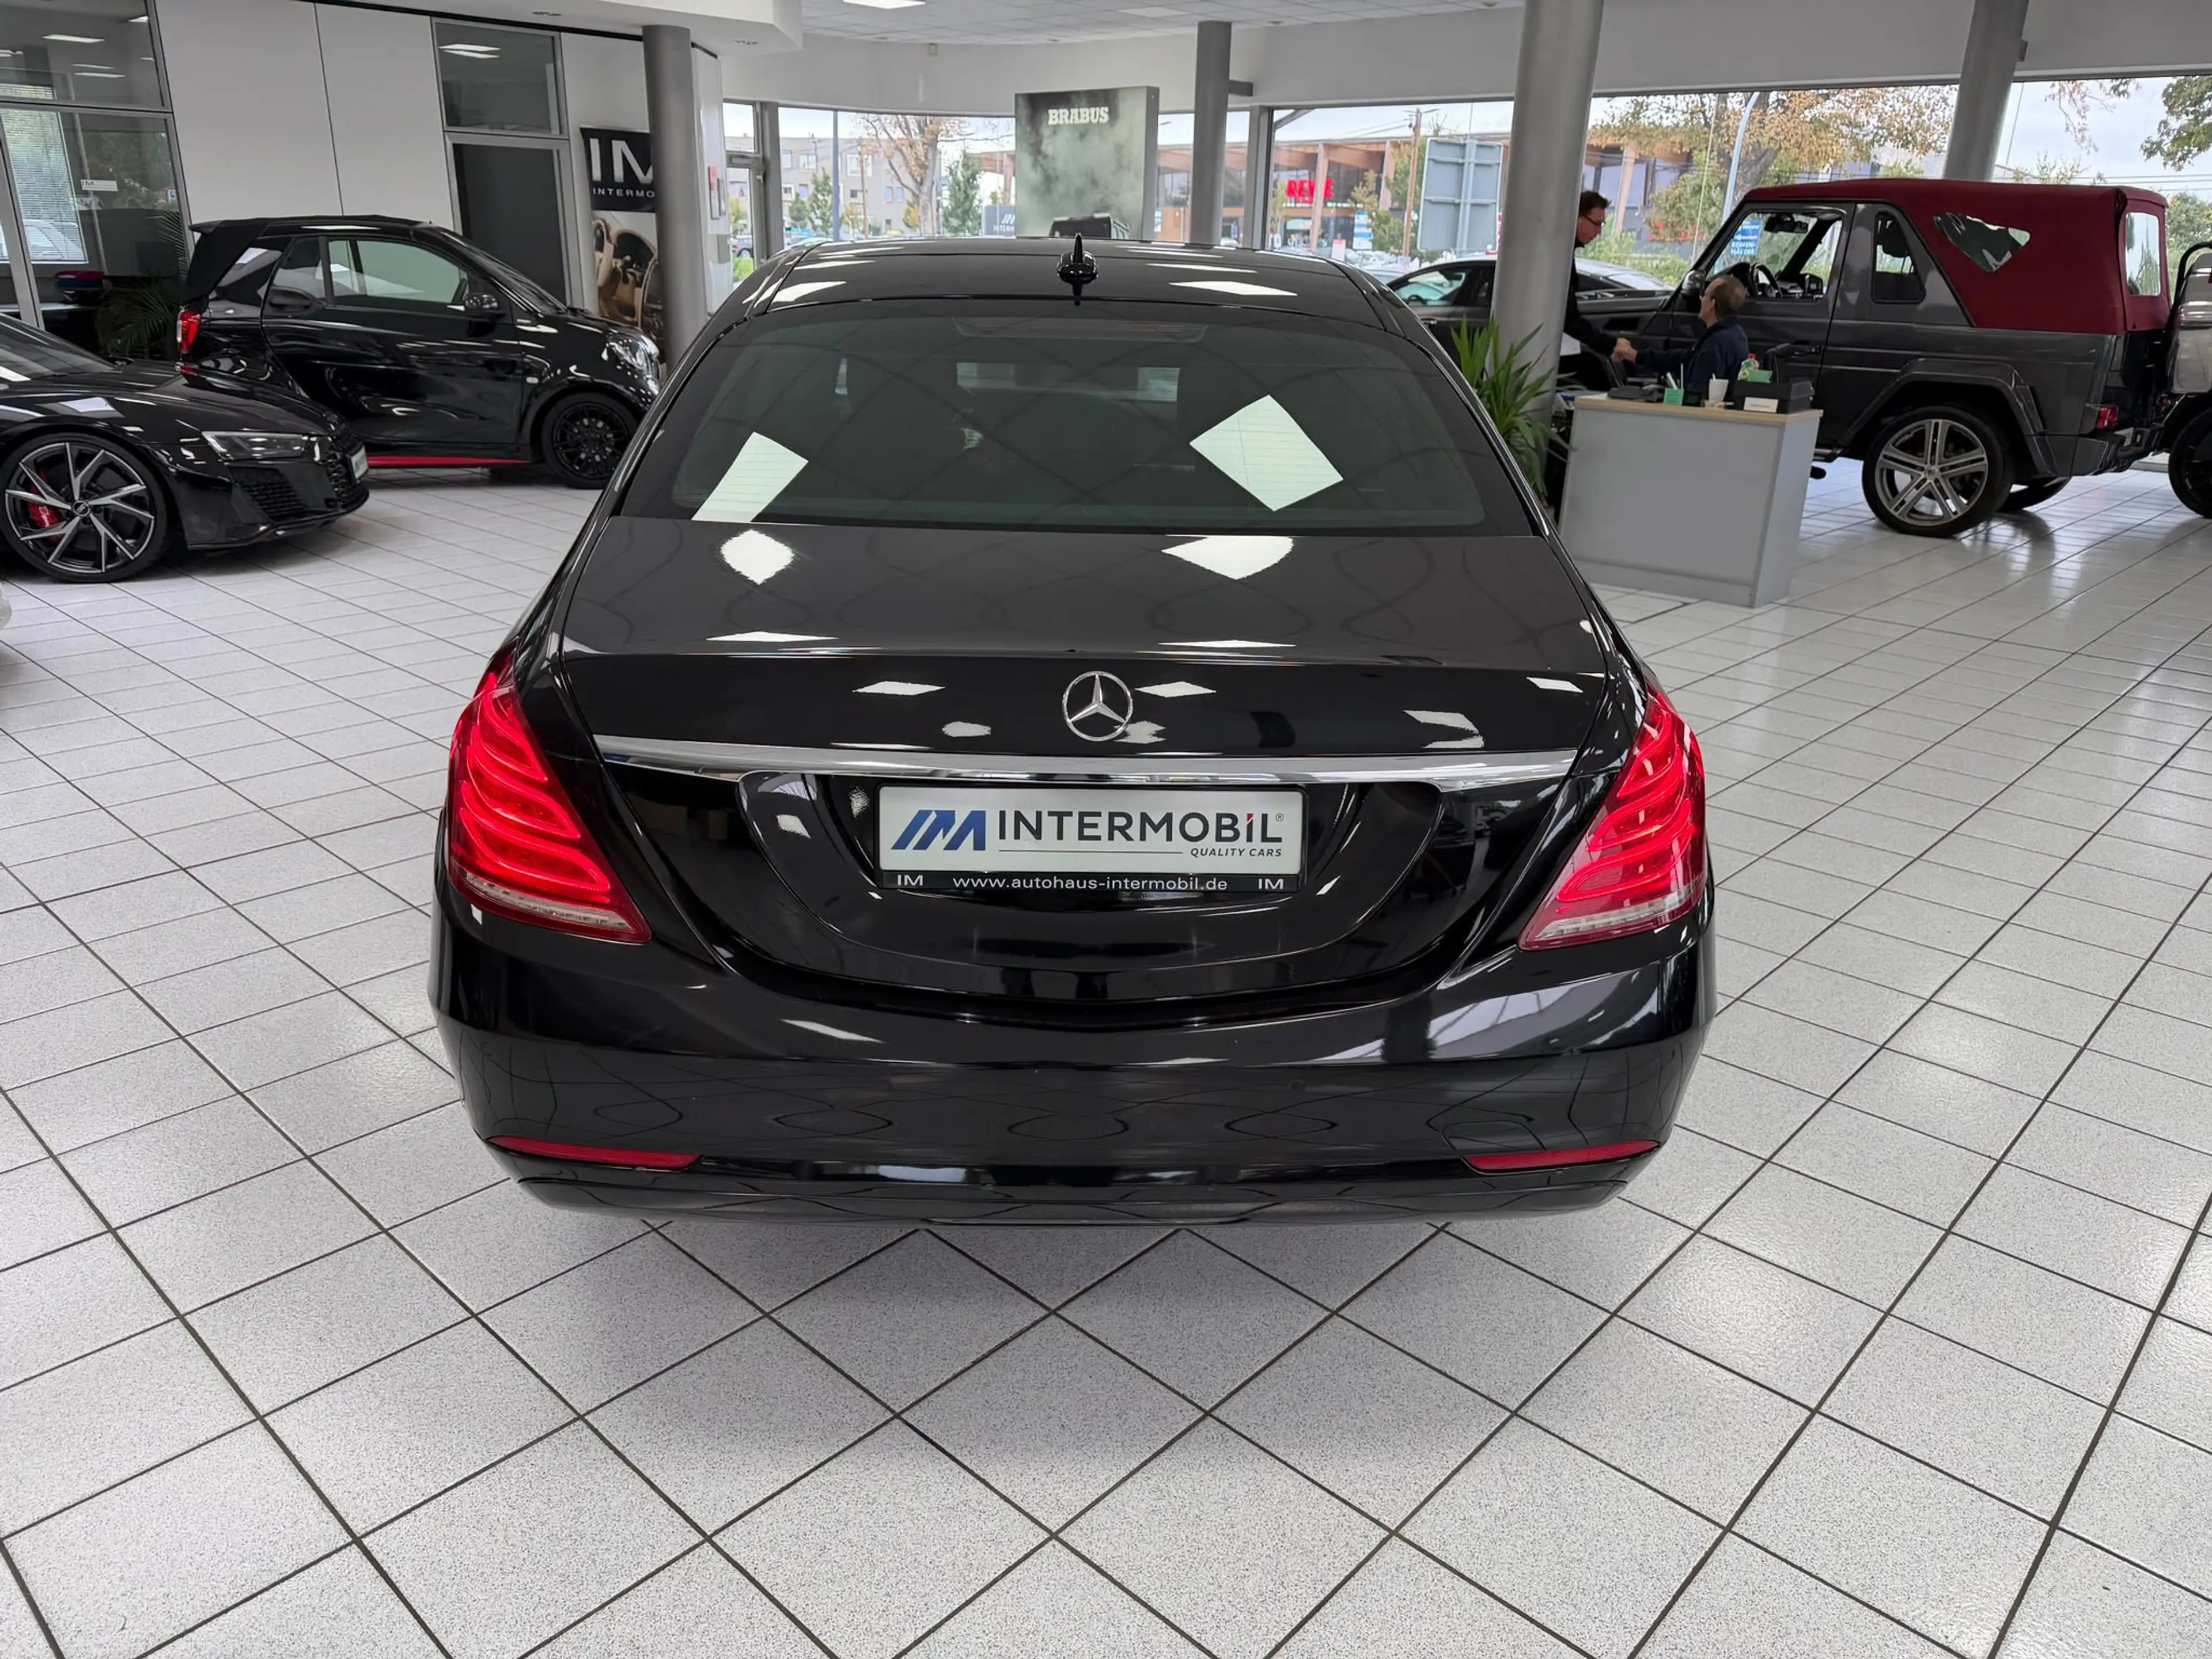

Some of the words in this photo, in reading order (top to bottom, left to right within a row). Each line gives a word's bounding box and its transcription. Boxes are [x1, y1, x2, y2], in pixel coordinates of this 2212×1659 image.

[1048, 107, 1109, 125] BRABUS
[1190, 847, 1245, 858] QUALITY
[1249, 848, 1282, 857] CARS
[897, 874, 923, 886] IM
[952, 876, 1228, 891] www.autohaus-intermobil.de
[1258, 878, 1284, 889] IM
